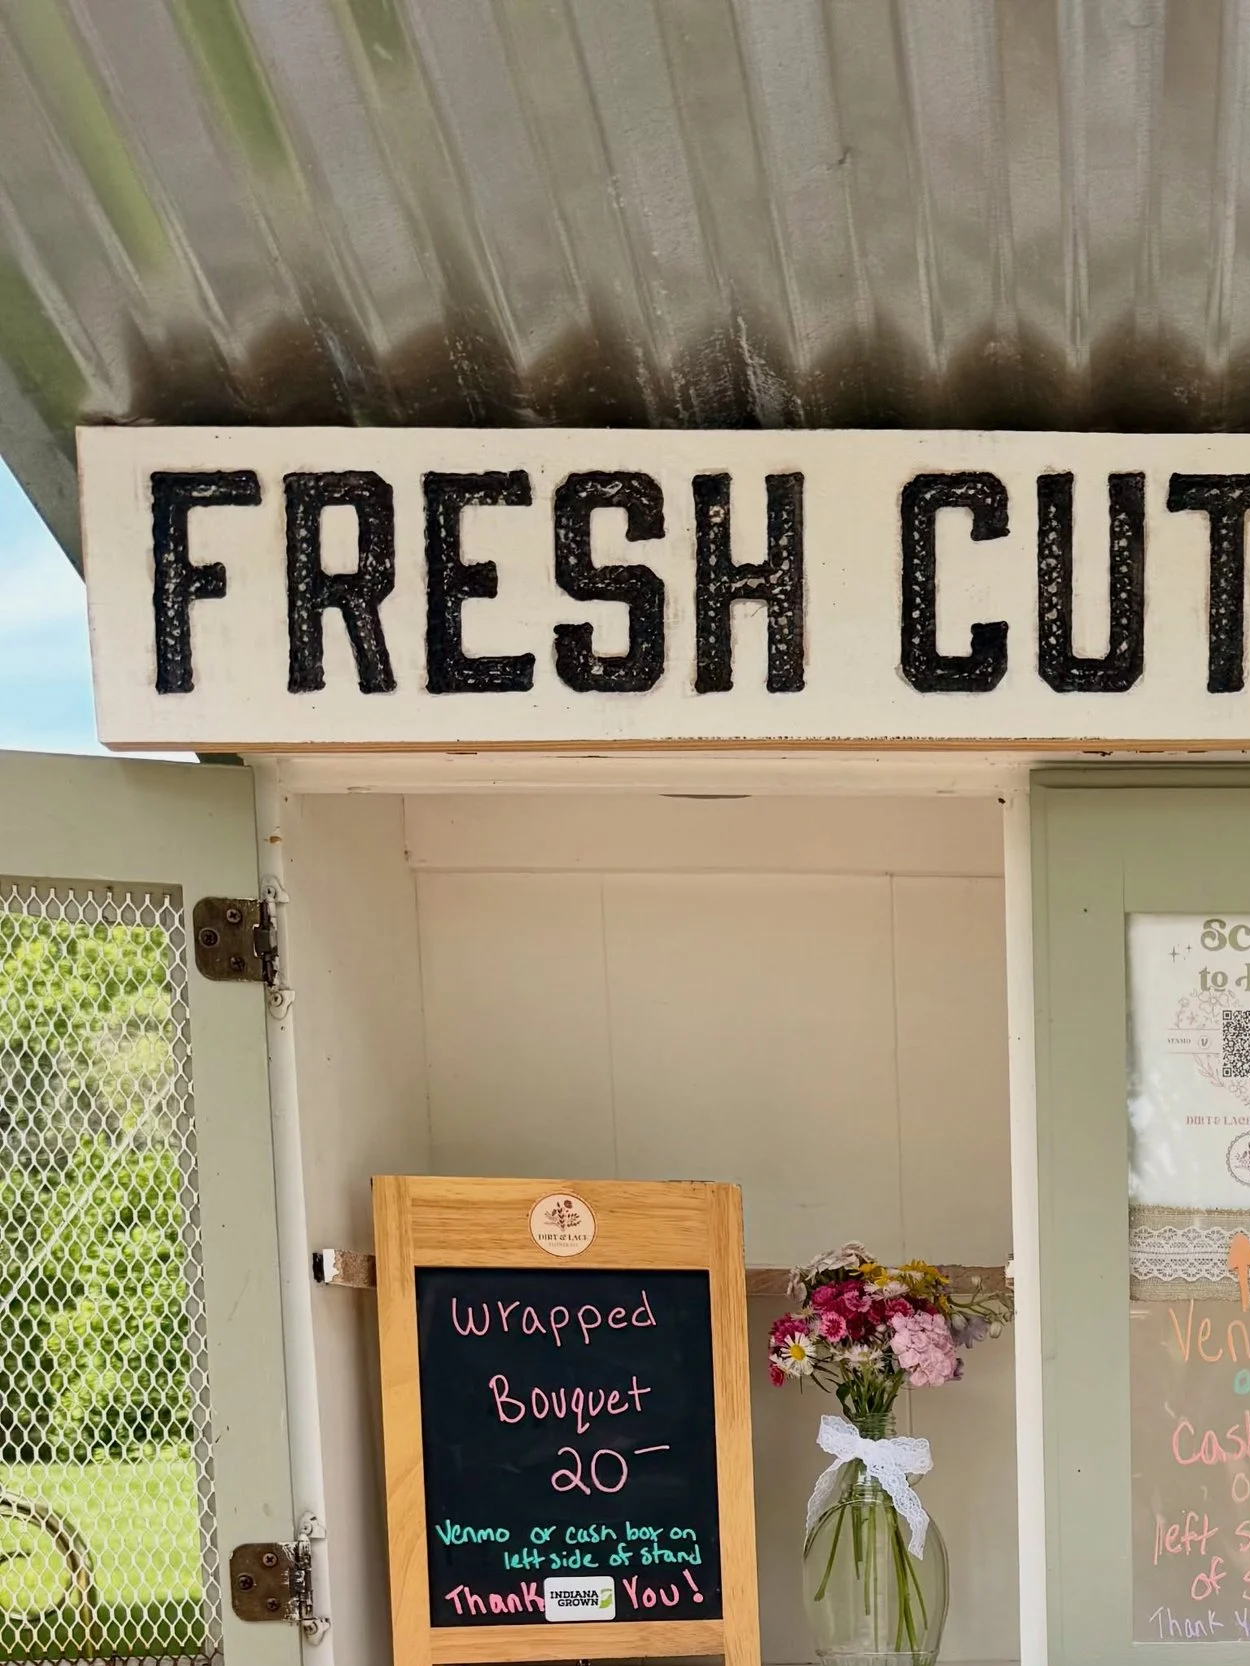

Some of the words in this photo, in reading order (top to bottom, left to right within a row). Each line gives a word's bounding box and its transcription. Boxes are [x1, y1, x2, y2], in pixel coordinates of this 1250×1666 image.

[150, 469, 806, 694] FRESH
[1198, 965, 1229, 992] to
[451, 1290, 658, 1347] Wrapped
[488, 1374, 652, 1434] Bouquet
[436, 1519, 510, 1546] Venmo
[530, 1524, 557, 1545] or
[565, 1525, 618, 1545] cash
[625, 1520, 664, 1542] box
[669, 1527, 697, 1542] on
[1152, 1510, 1219, 1566] left
[503, 1548, 546, 1570] left
[549, 1549, 600, 1570] side
[608, 1542, 633, 1567] of
[639, 1543, 703, 1566] stand
[550, 1590, 599, 1599] INDIANA
[1191, 1555, 1227, 1600] of
[557, 1598, 599, 1607] GROWN
